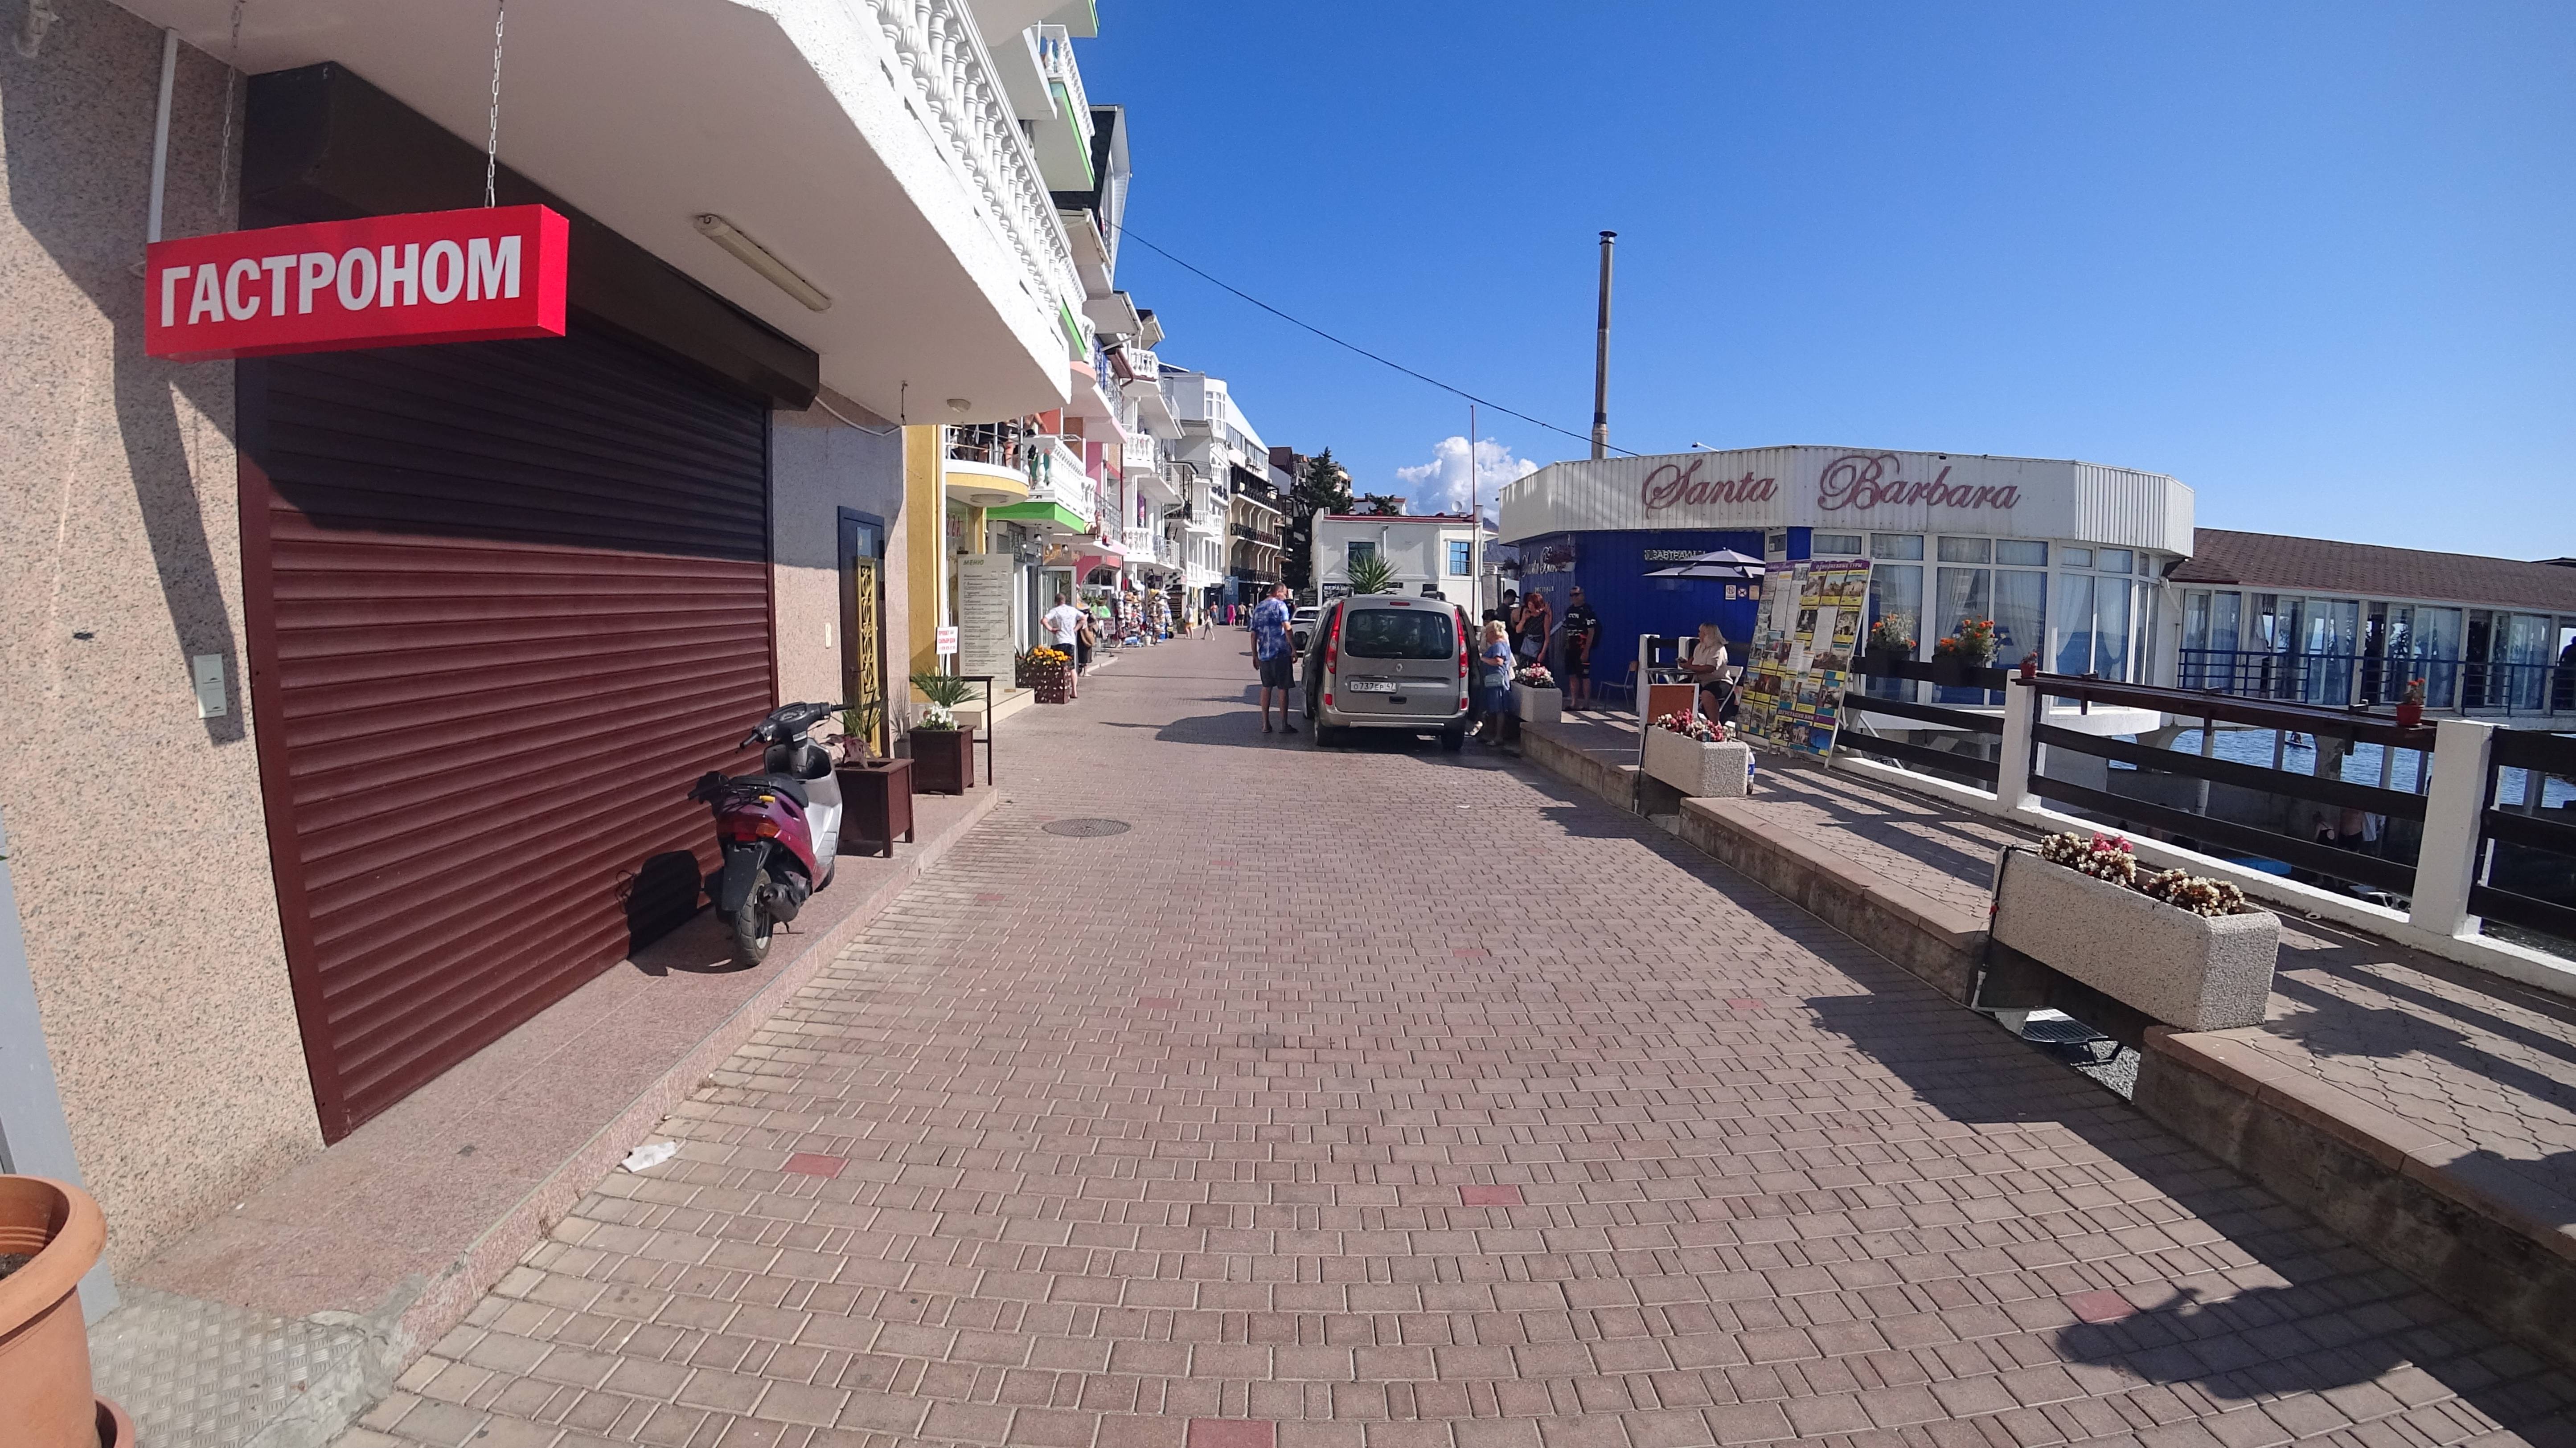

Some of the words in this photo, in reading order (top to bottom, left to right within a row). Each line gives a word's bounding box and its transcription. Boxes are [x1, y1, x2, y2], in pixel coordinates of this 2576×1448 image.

[161, 235, 521, 327] ГАСТРОНОМ
[1642, 459, 1778, 519] Santa
[1817, 454, 2021, 511] Barbara
[1653, 551, 1696, 559] ЗАВТРАКИ
